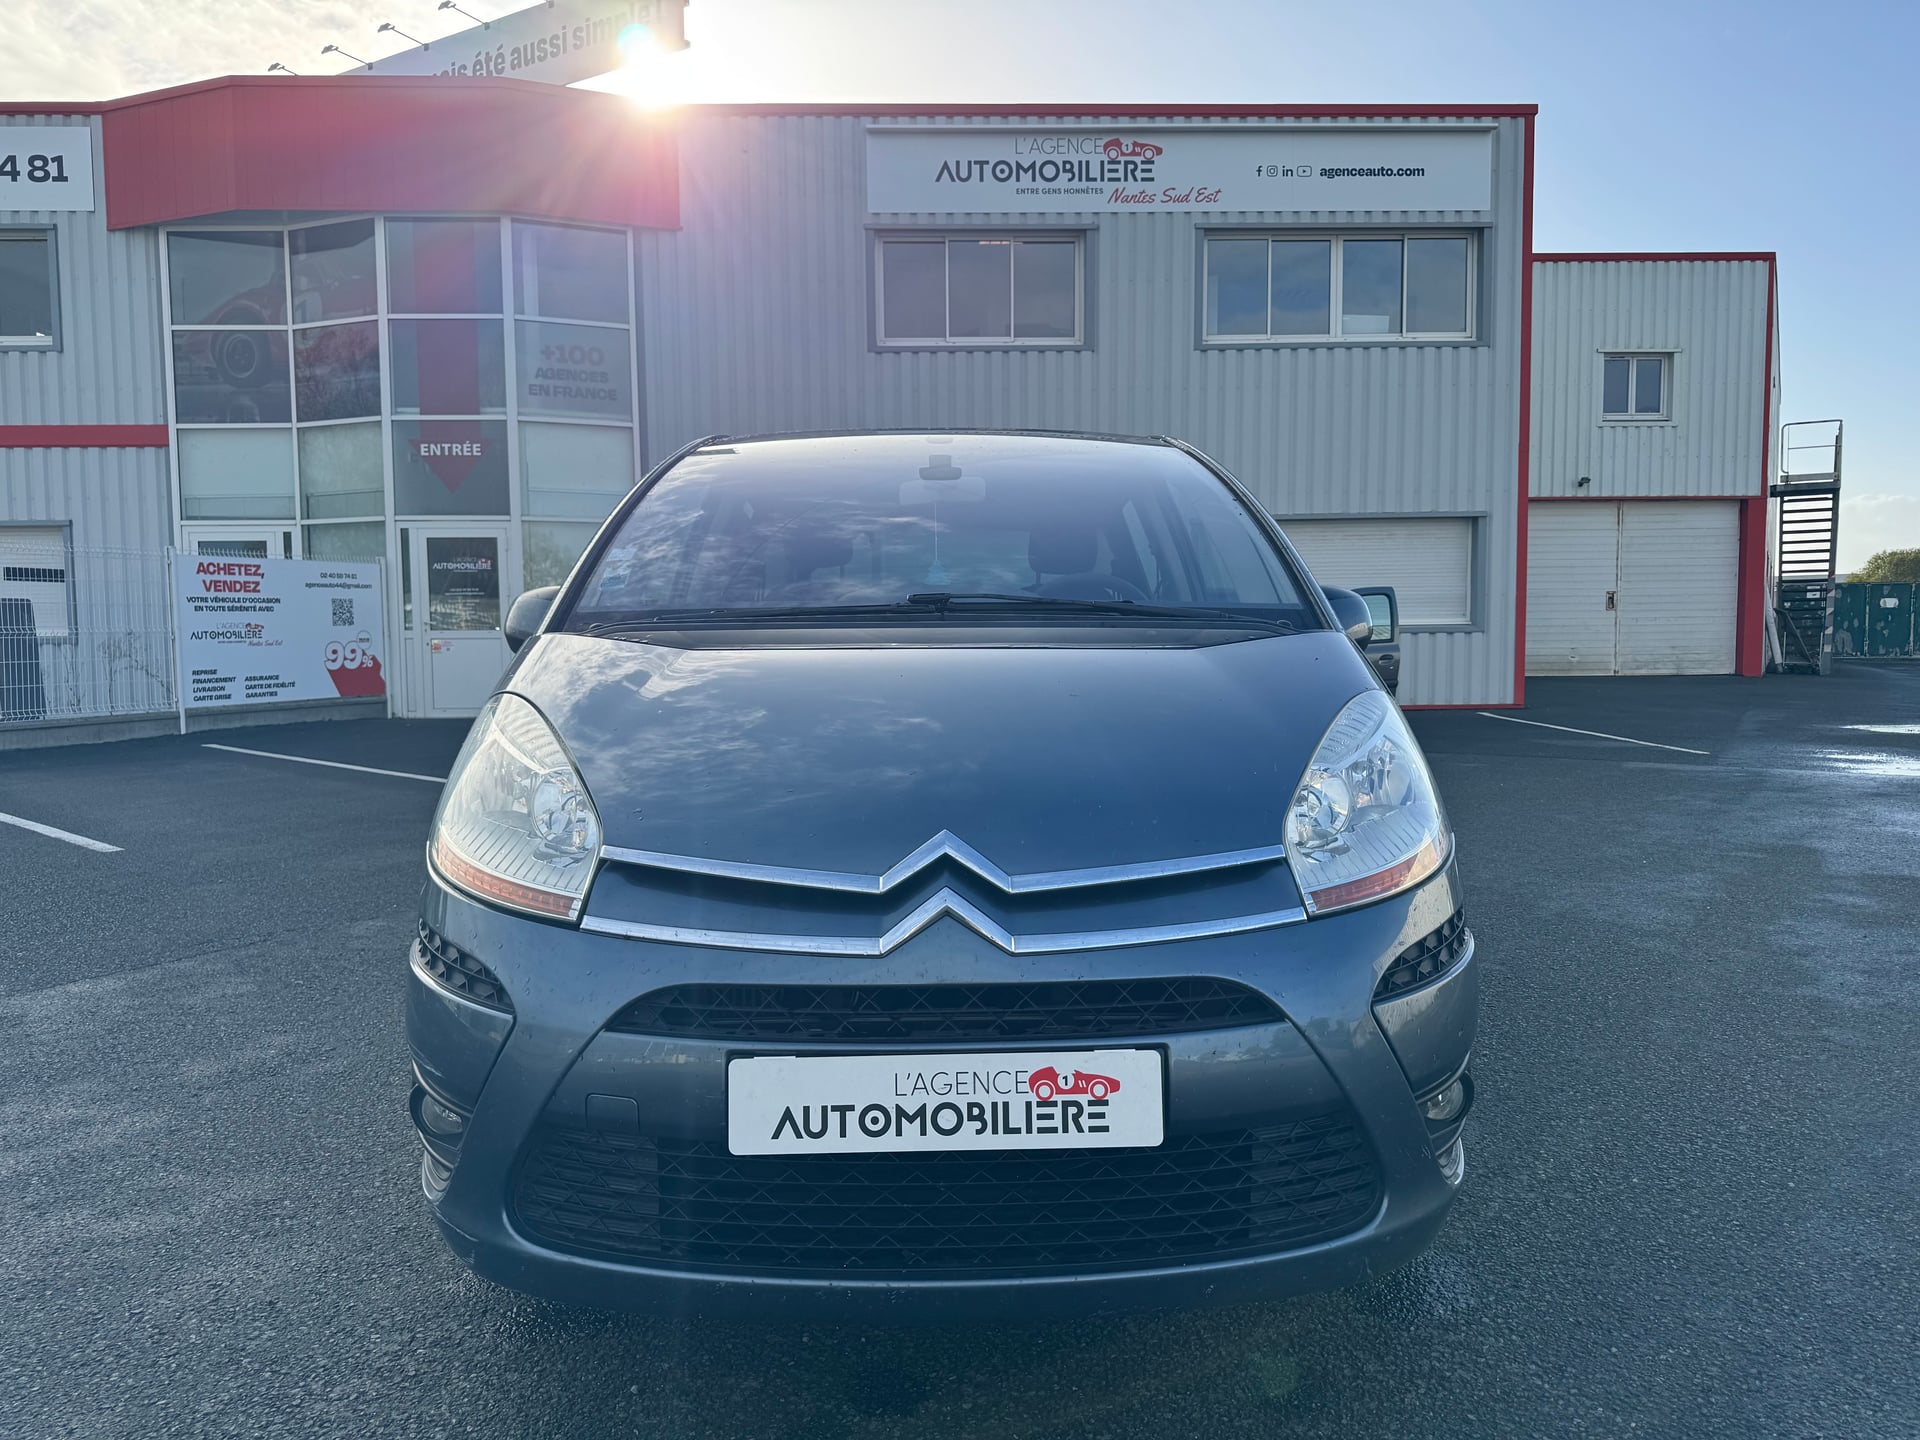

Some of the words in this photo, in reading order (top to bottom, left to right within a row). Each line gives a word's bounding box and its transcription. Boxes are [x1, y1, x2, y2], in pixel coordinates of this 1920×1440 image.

[472, 43, 506, 77] été
[510, 26, 568, 72] aussi
[1014, 137, 1105, 155] L'AGENCE
[27, 154, 69, 183] 81
[1319, 166, 1425, 179] agenceauto.com
[1016, 187, 1040, 195] ENTRE
[1041, 187, 1061, 195] GENS
[1062, 185, 1104, 195] HONNÊTES
[1107, 187, 1157, 204] Nantes
[1160, 187, 1192, 204] Sud
[1194, 187, 1224, 203] Est
[541, 343, 605, 367] +100
[535, 367, 609, 383] AGENCES
[528, 383, 552, 397] EN
[553, 385, 617, 401] FRANCE
[420, 441, 482, 456] ENTRÉE
[196, 562, 265, 579] ACHETEZ,
[202, 579, 261, 593] VENDEZ
[209, 595, 240, 604] VÉHICULE
[242, 596, 281, 605] D'OCCASION
[226, 604, 257, 613] SÉRÉNITÉ
[244, 674, 280, 682] ASSURANCE
[272, 681, 296, 689] FIDÉLITÉ
[193, 685, 226, 693] LIVRAISON
[245, 690, 278, 698] GARANTIES
[193, 694, 213, 702] CARTE
[214, 693, 232, 701] GRISE
[894, 1070, 1029, 1097] L'AGENCE
